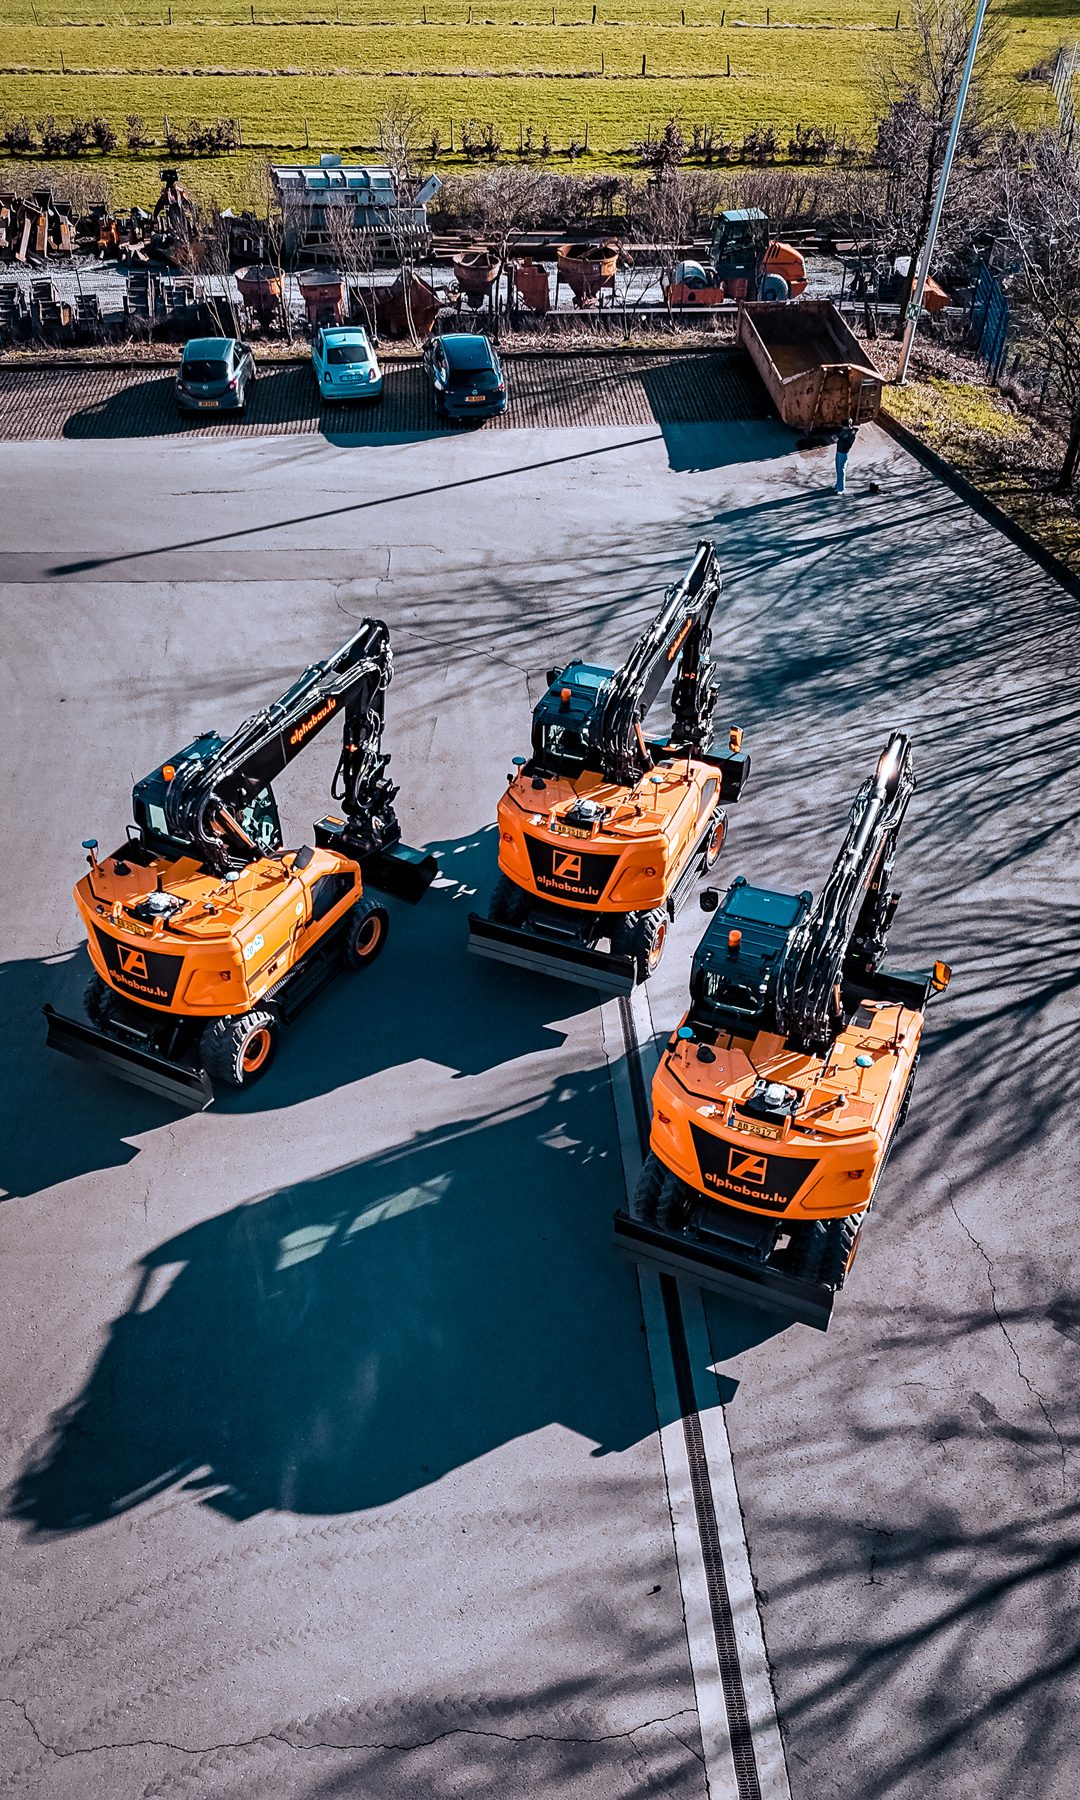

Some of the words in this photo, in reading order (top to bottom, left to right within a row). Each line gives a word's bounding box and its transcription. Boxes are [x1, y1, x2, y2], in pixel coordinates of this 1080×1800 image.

[290, 698, 336, 744] alphabau.lu
[537, 875, 599, 896] alphabau.lu
[109, 969, 168, 998] alphabau.lu
[750, 1125, 772, 1136] 2517
[704, 1172, 788, 1203] alphabau.lu
